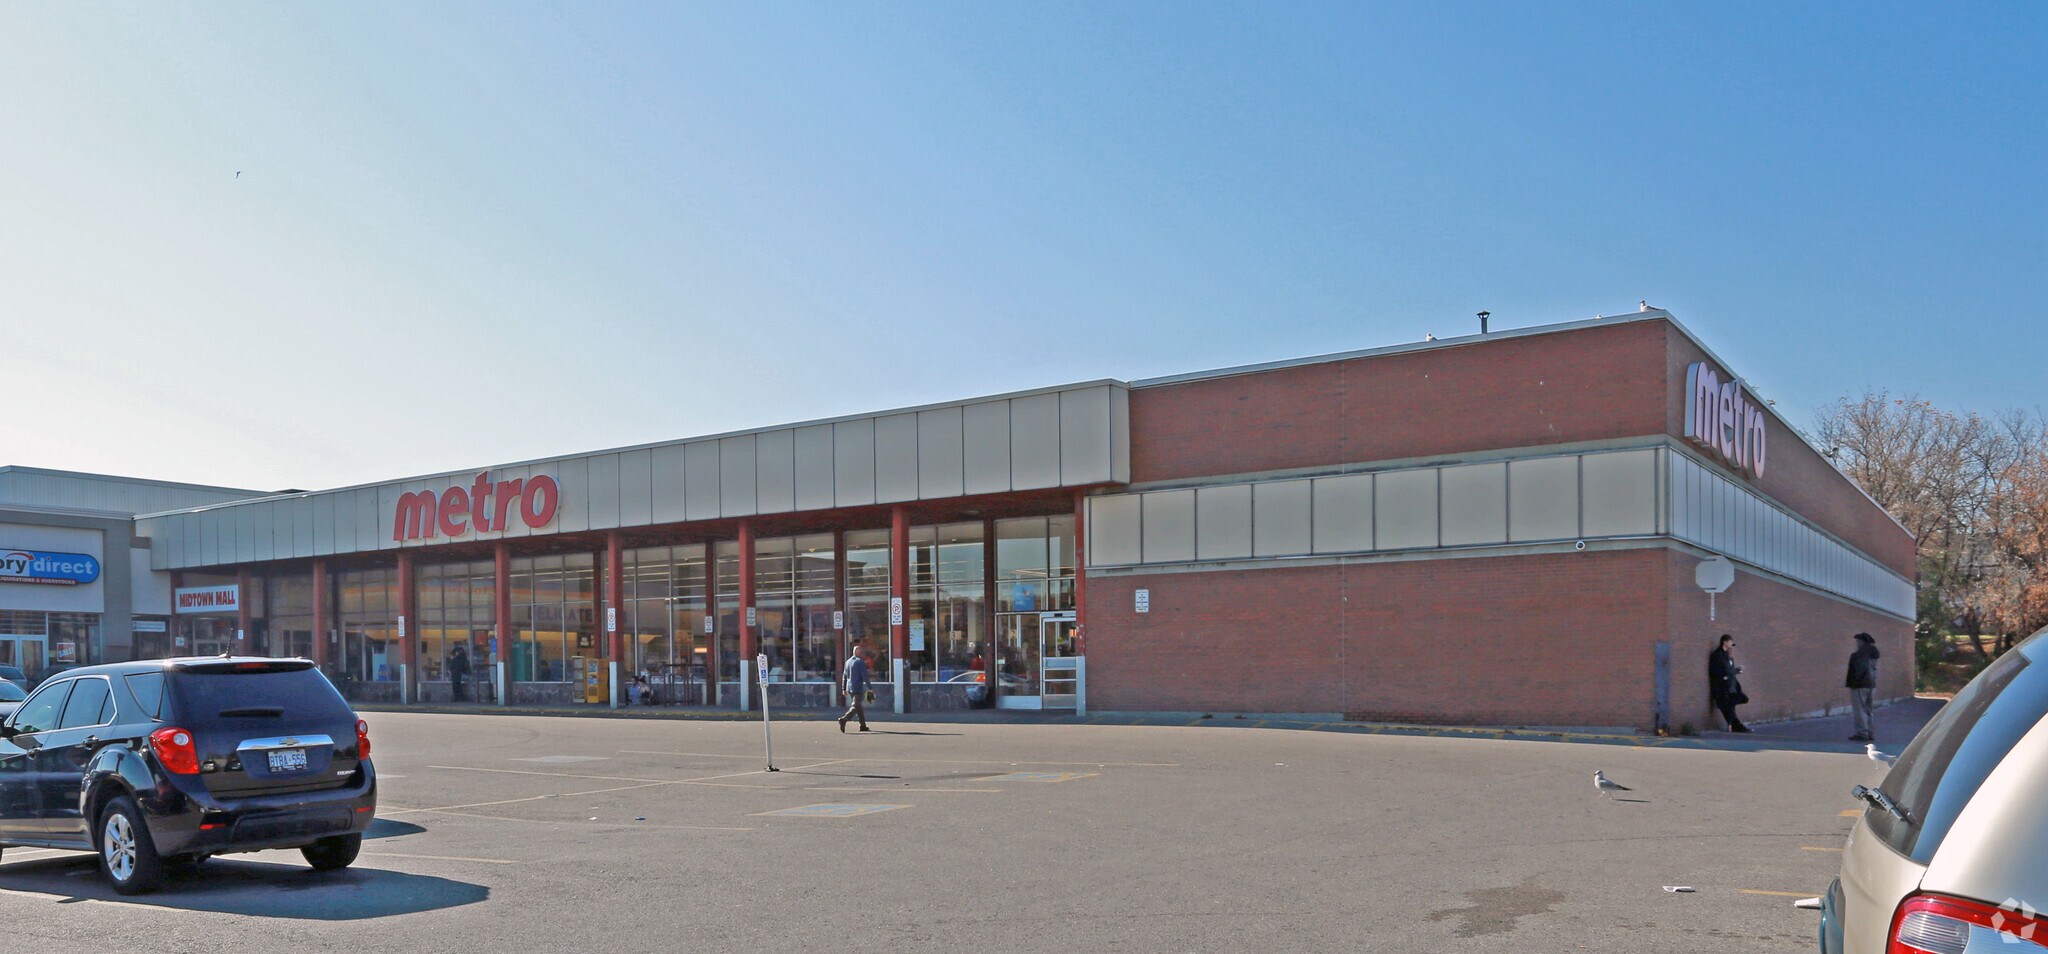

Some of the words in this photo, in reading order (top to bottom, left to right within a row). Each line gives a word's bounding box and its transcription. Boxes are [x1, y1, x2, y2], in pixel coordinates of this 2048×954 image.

[1694, 361, 1766, 480] metro
[393, 470, 559, 541] metro
[33, 556, 93, 575] direct
[180, 591, 214, 607] MIDTOWN
[216, 590, 235, 605] MALL
